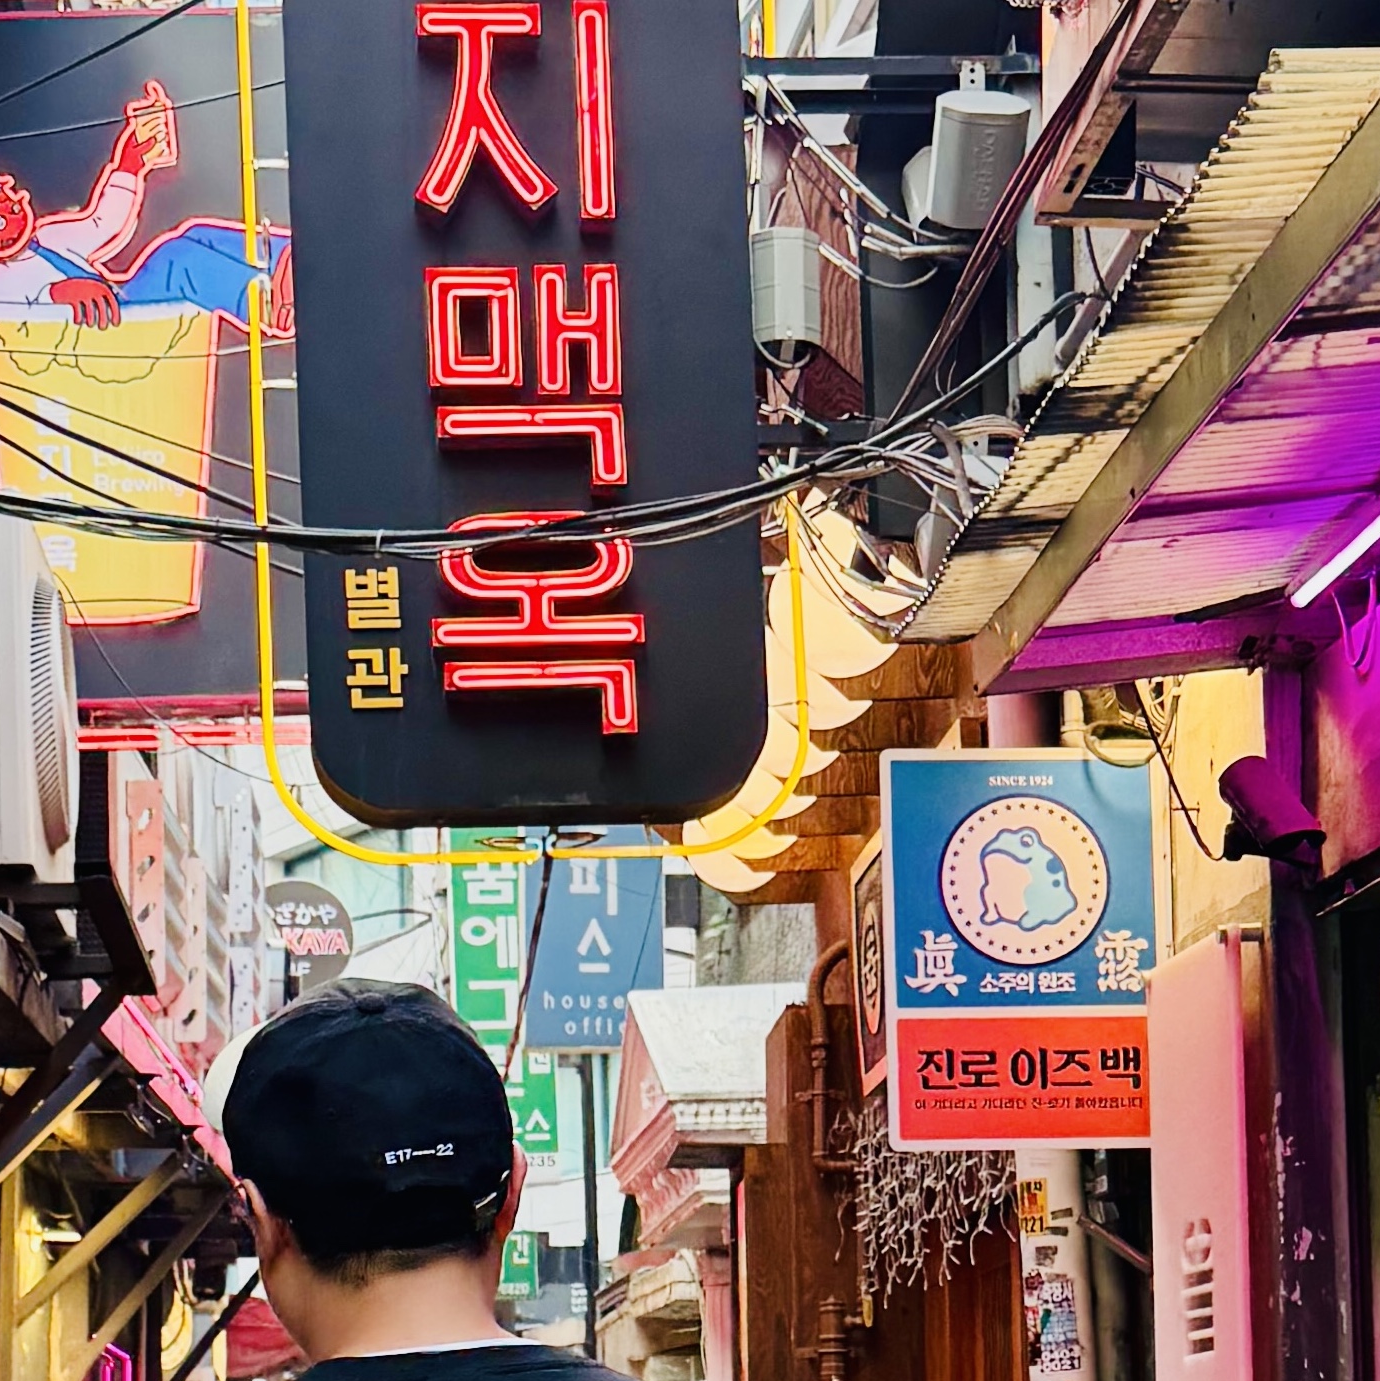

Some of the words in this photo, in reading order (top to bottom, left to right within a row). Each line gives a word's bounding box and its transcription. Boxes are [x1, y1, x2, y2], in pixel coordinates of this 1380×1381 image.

[343, 567, 409, 710] 별관
[989, 775, 1026, 787] SINCE
[570, 857, 618, 973] 피스
[904, 929, 967, 997] 眞
[979, 971, 1034, 994] 소주의
[1038, 971, 1077, 994] 원조
[543, 989, 625, 1010] house
[916, 1046, 1000, 1091] 진로
[1010, 1046, 1094, 1091] 이즈
[1100, 1046, 1142, 1090] 백
